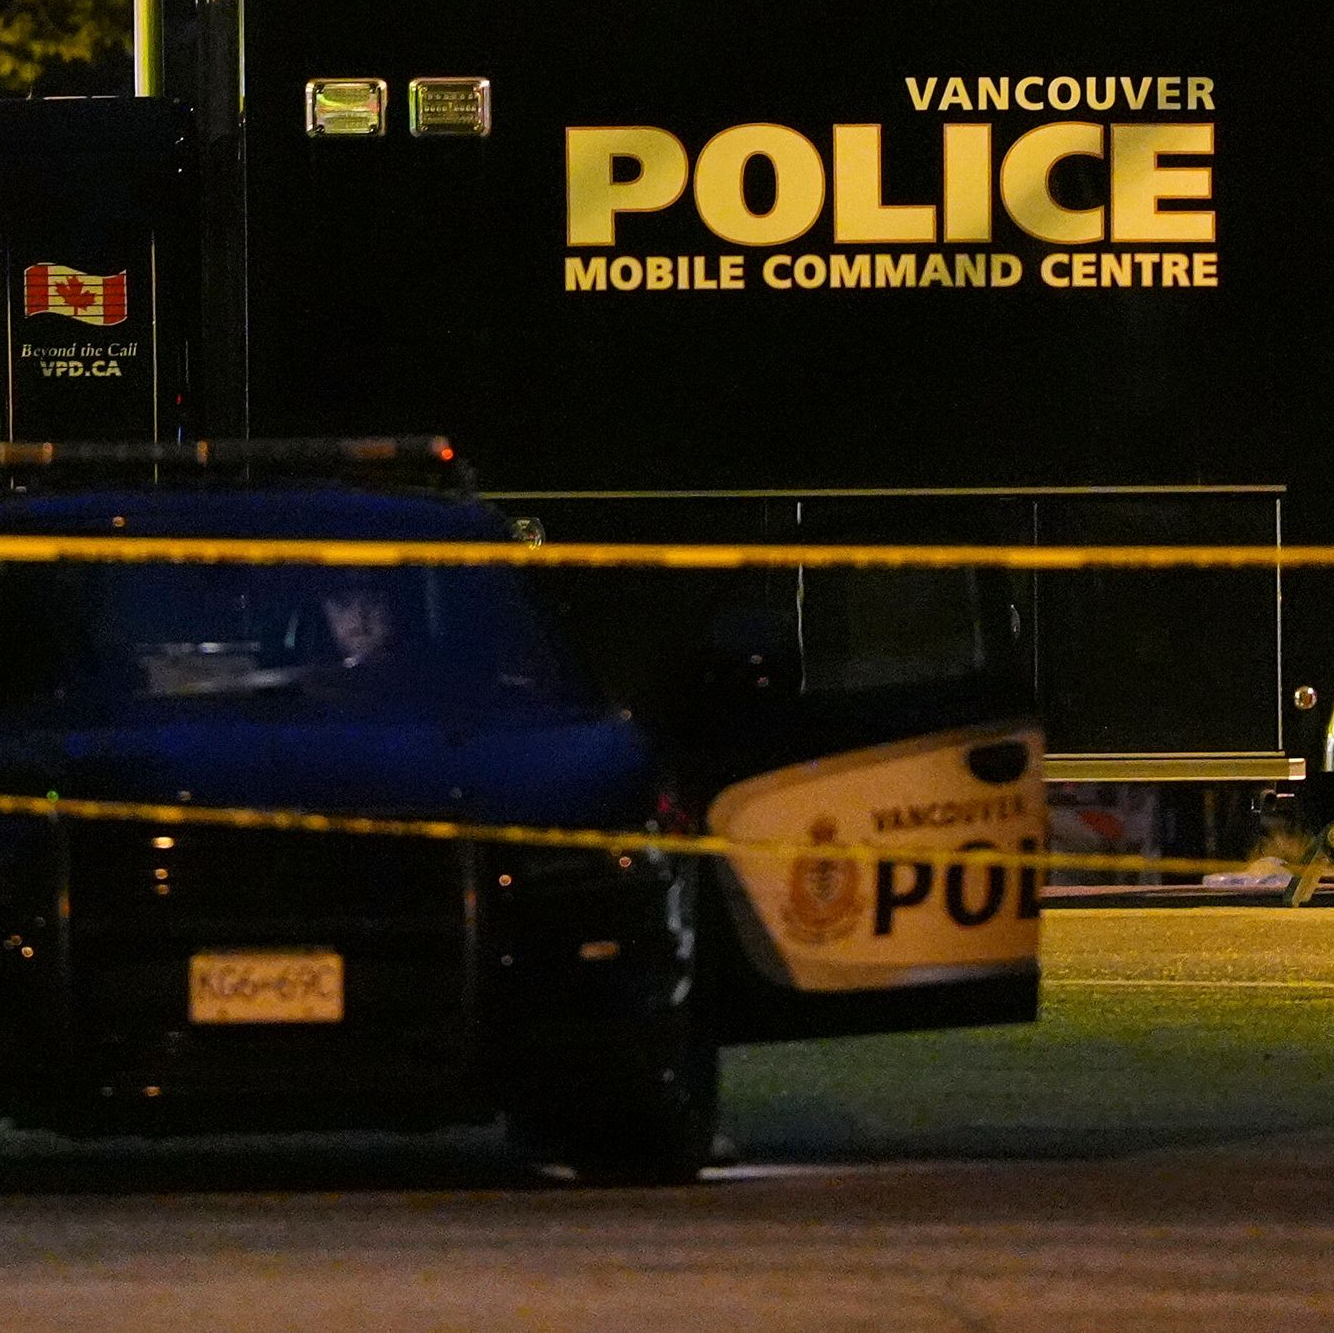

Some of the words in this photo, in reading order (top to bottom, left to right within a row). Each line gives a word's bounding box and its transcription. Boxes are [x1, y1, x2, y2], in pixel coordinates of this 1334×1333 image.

[905, 76, 1217, 111] VANCOUVER
[564, 121, 1218, 247] POLICE
[564, 256, 746, 291] MOBILE
[762, 254, 1023, 289] COMMAND
[1040, 252, 1219, 288] CENTRE
[21, 343, 77, 360] Beyond
[80, 343, 104, 357] the
[107, 342, 138, 357] Call
[40, 360, 122, 377] VPD.CA
